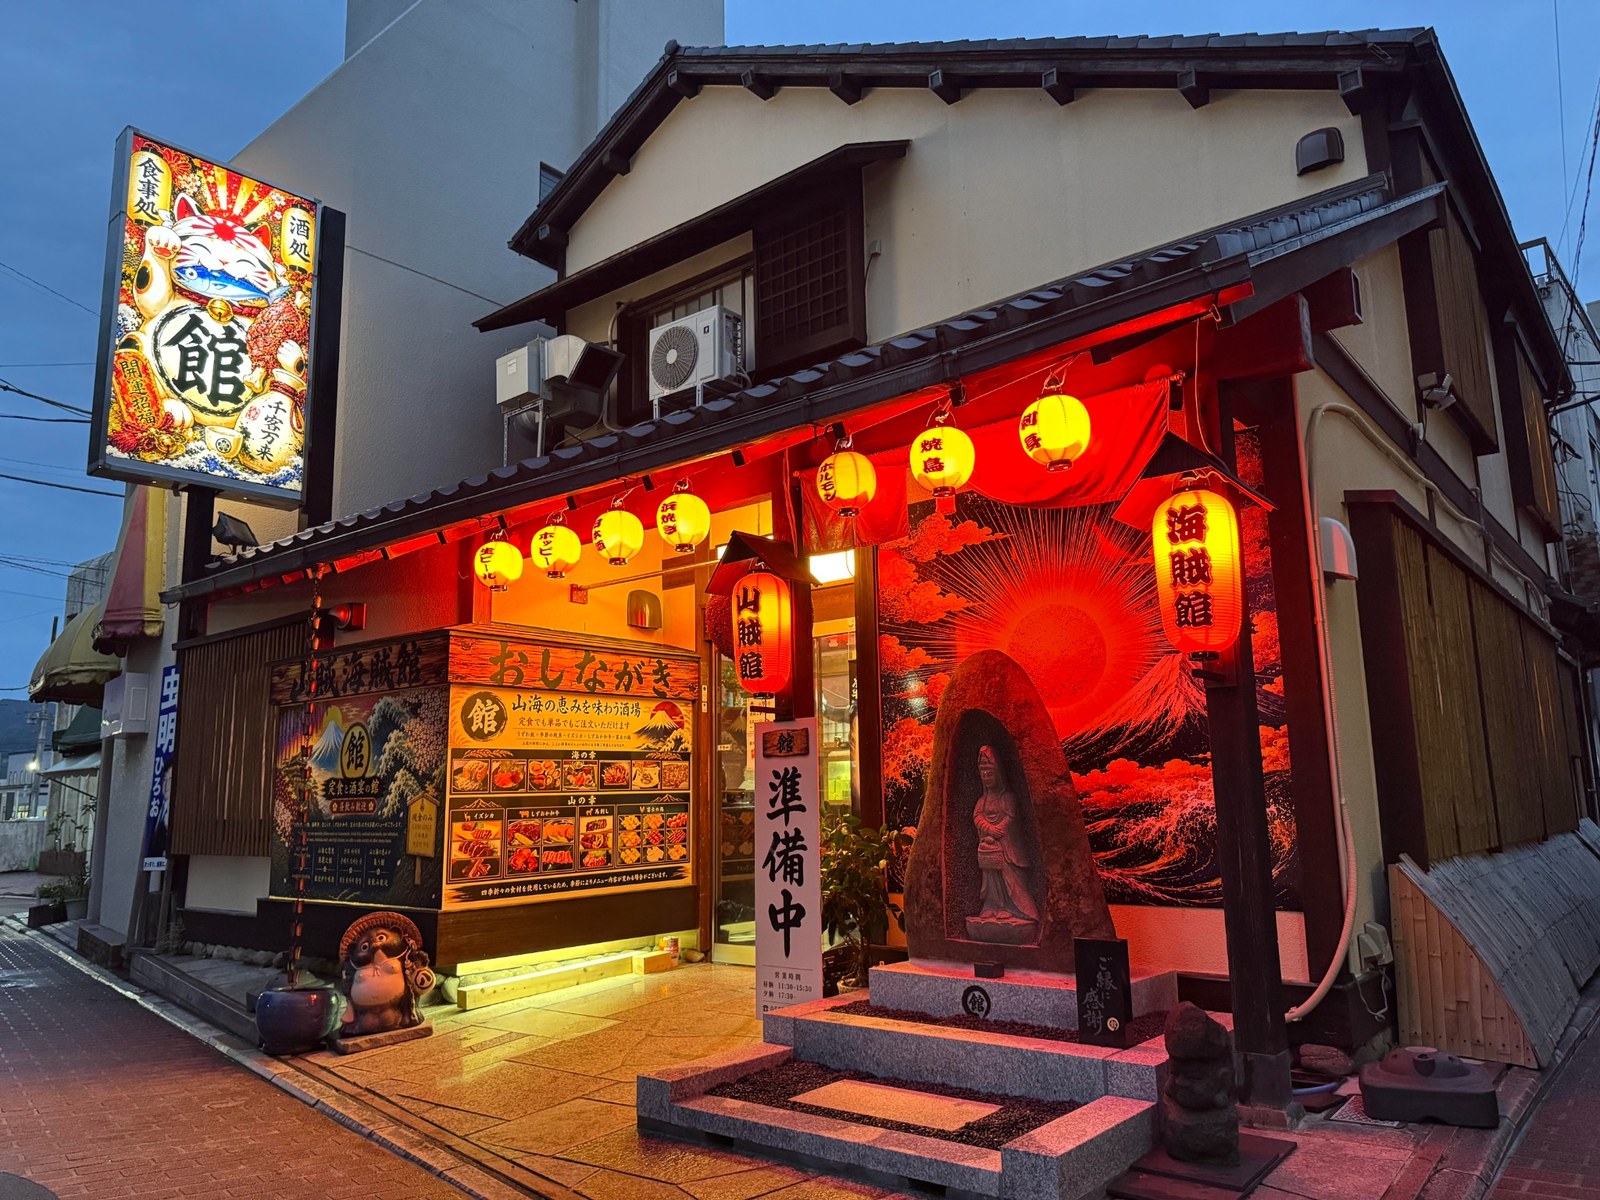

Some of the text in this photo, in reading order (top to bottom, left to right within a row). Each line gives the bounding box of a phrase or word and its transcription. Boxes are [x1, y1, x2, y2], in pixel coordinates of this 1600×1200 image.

[134, 157, 164, 222] 食事処
[288, 215, 310, 263] 酒処
[161, 313, 249, 407] 館
[119, 360, 157, 426] 開運招福
[256, 401, 287, 462] 千客万来
[920, 437, 945, 474] 焼鳥
[819, 462, 837, 502] ホルモン
[479, 547, 496, 581] 生ビール
[538, 531, 555, 566] ホッピー
[1166, 504, 1214, 629] 海賊館
[736, 586, 764, 680] 山賊館
[488, 640, 672, 699] おしながき
[467, 698, 500, 734] 館
[511, 694, 642, 718] 山海の恵みを味わう酒場
[518, 717, 631, 730] 定食でも単品でもご注文いただけます
[345, 730, 366, 772] 館
[570, 750, 597, 760] 海の幸
[327, 778, 380, 797] 定食と酒宴の館
[567, 795, 598, 806] 山の幸
[762, 766, 809, 959] 準備中
[967, 992, 985, 1011] 館
